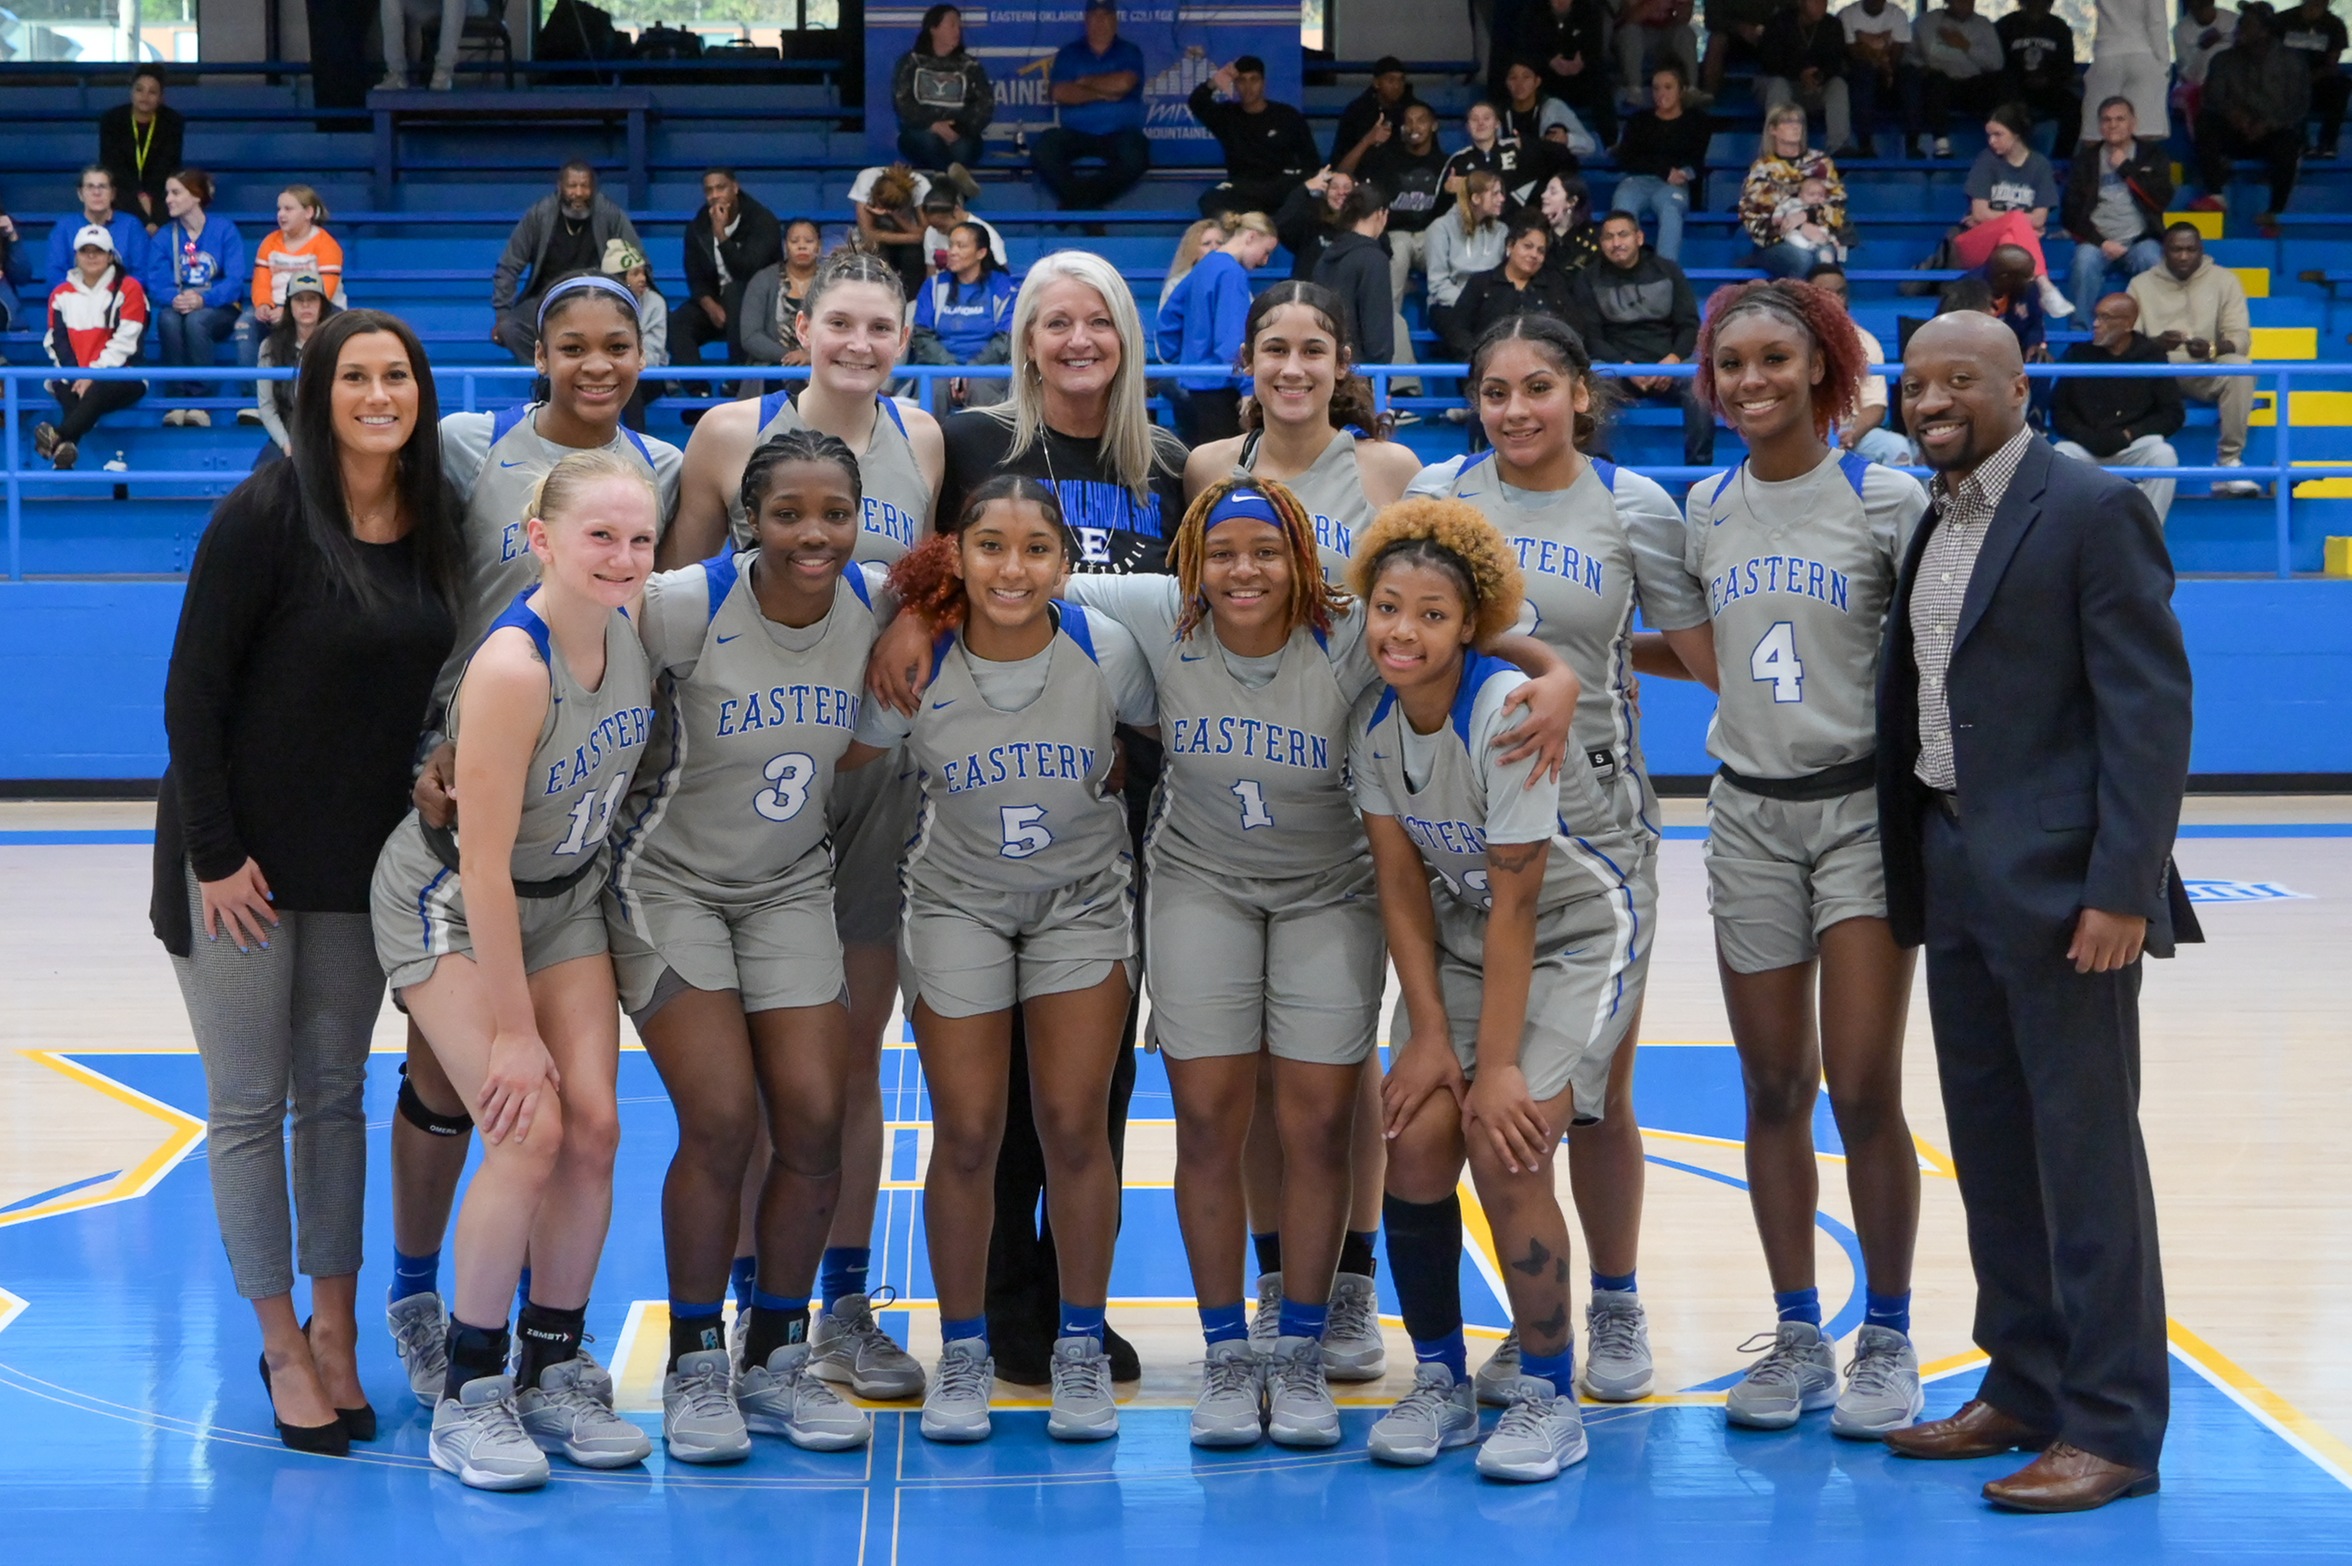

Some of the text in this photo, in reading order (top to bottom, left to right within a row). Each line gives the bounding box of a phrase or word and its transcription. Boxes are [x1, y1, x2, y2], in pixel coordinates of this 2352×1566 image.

[990, 11, 1036, 23] EASTERN
[989, 79, 1050, 106] AINE
[1501, 150, 1517, 170] E
[861, 495, 915, 552] ERN
[1077, 526, 1111, 563] E
[1313, 513, 1351, 559] RN
[1505, 535, 1603, 598] TERN
[1710, 554, 1850, 621] EASTERN
[1750, 621, 1804, 703] 4
[715, 683, 861, 738] EASTERN
[943, 740, 1096, 794] EASTERN
[1173, 715, 1330, 770] EASTERN
[1595, 753, 1605, 764] S
[551, 770, 628, 856] 11
[753, 751, 817, 822] 3
[1230, 778, 1274, 831] 1
[999, 803, 1056, 859] 5
[1395, 814, 1488, 855] STER
